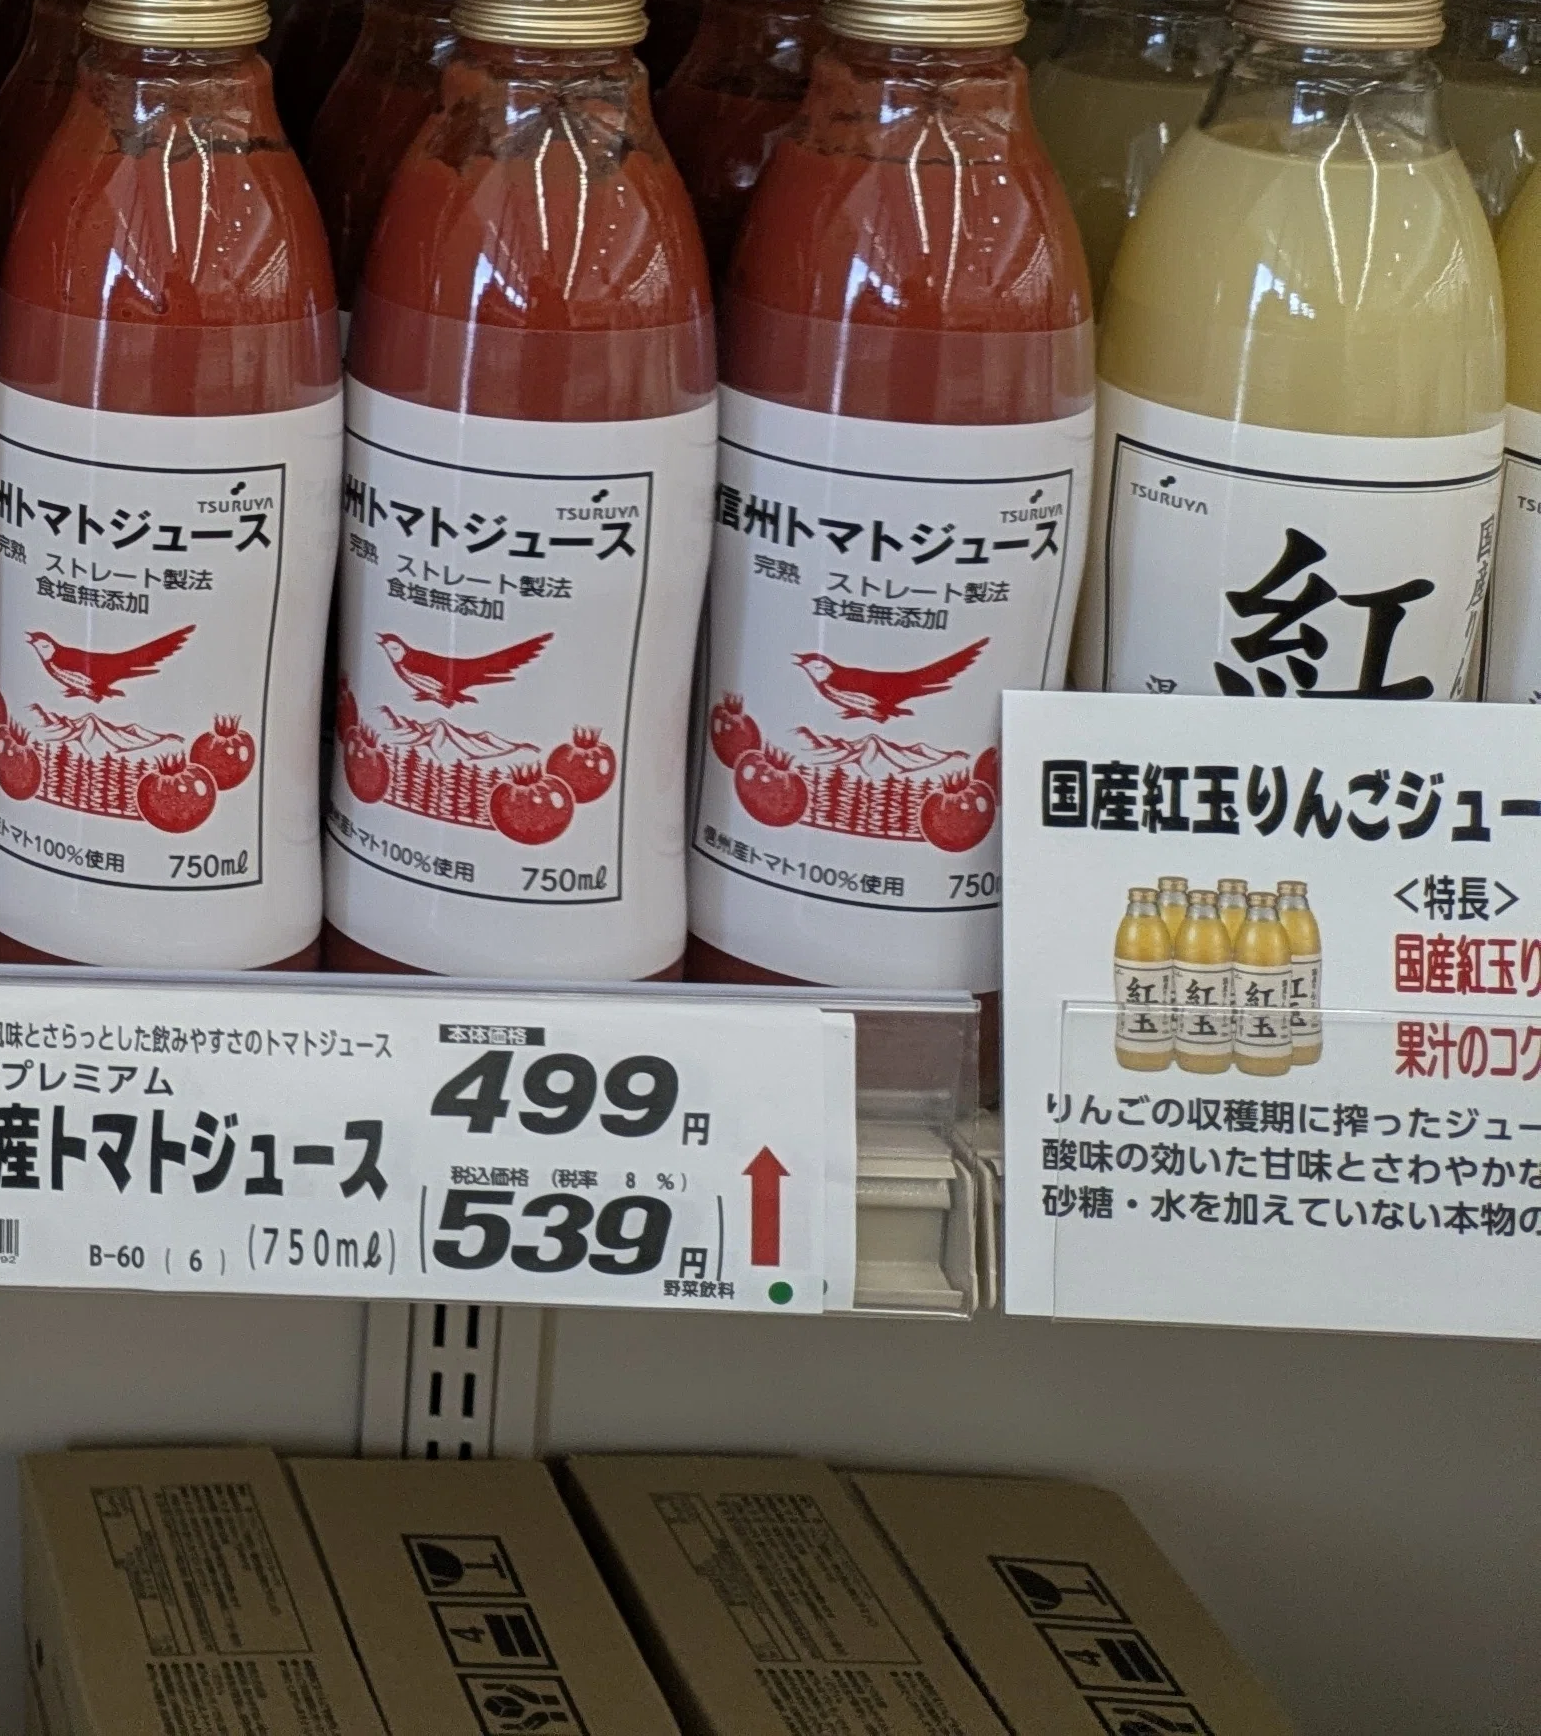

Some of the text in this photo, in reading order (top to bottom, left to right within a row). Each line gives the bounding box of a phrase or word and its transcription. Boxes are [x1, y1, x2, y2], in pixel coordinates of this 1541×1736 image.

[197, 499, 273, 515] TSURUYA
[556, 505, 639, 521] TSURUYA
[1000, 504, 1063, 524] TSURUYA
[1130, 481, 1208, 515] TSURUYA
[716, 482, 1059, 565] 信州トマトジュース
[46, 553, 213, 591] ストレート製法
[349, 533, 573, 600] 完熟 ストレート製法
[754, 553, 1010, 604] 完熟 ストレート製法
[36, 576, 149, 614] 食塩無添加
[387, 577, 504, 621] 食塩無添加
[812, 596, 947, 631] 食塩無添加
[1214, 527, 1434, 700] 紅
[1042, 759, 1541, 842] 国産紅玉りんごジュー
[447, 1024, 527, 1046] 本体価格
[1045, 1092, 1541, 1142] りんごの収穫期に搾ったジュー
[450, 1165, 529, 1187] 税込価格
[1042, 1137, 1541, 1189] 酸味の効いた甘味とさわやかな
[1042, 1184, 1541, 1237] 砂糖・水を加えていない本物の
[663, 1280, 735, 1299] 野菜飲料
